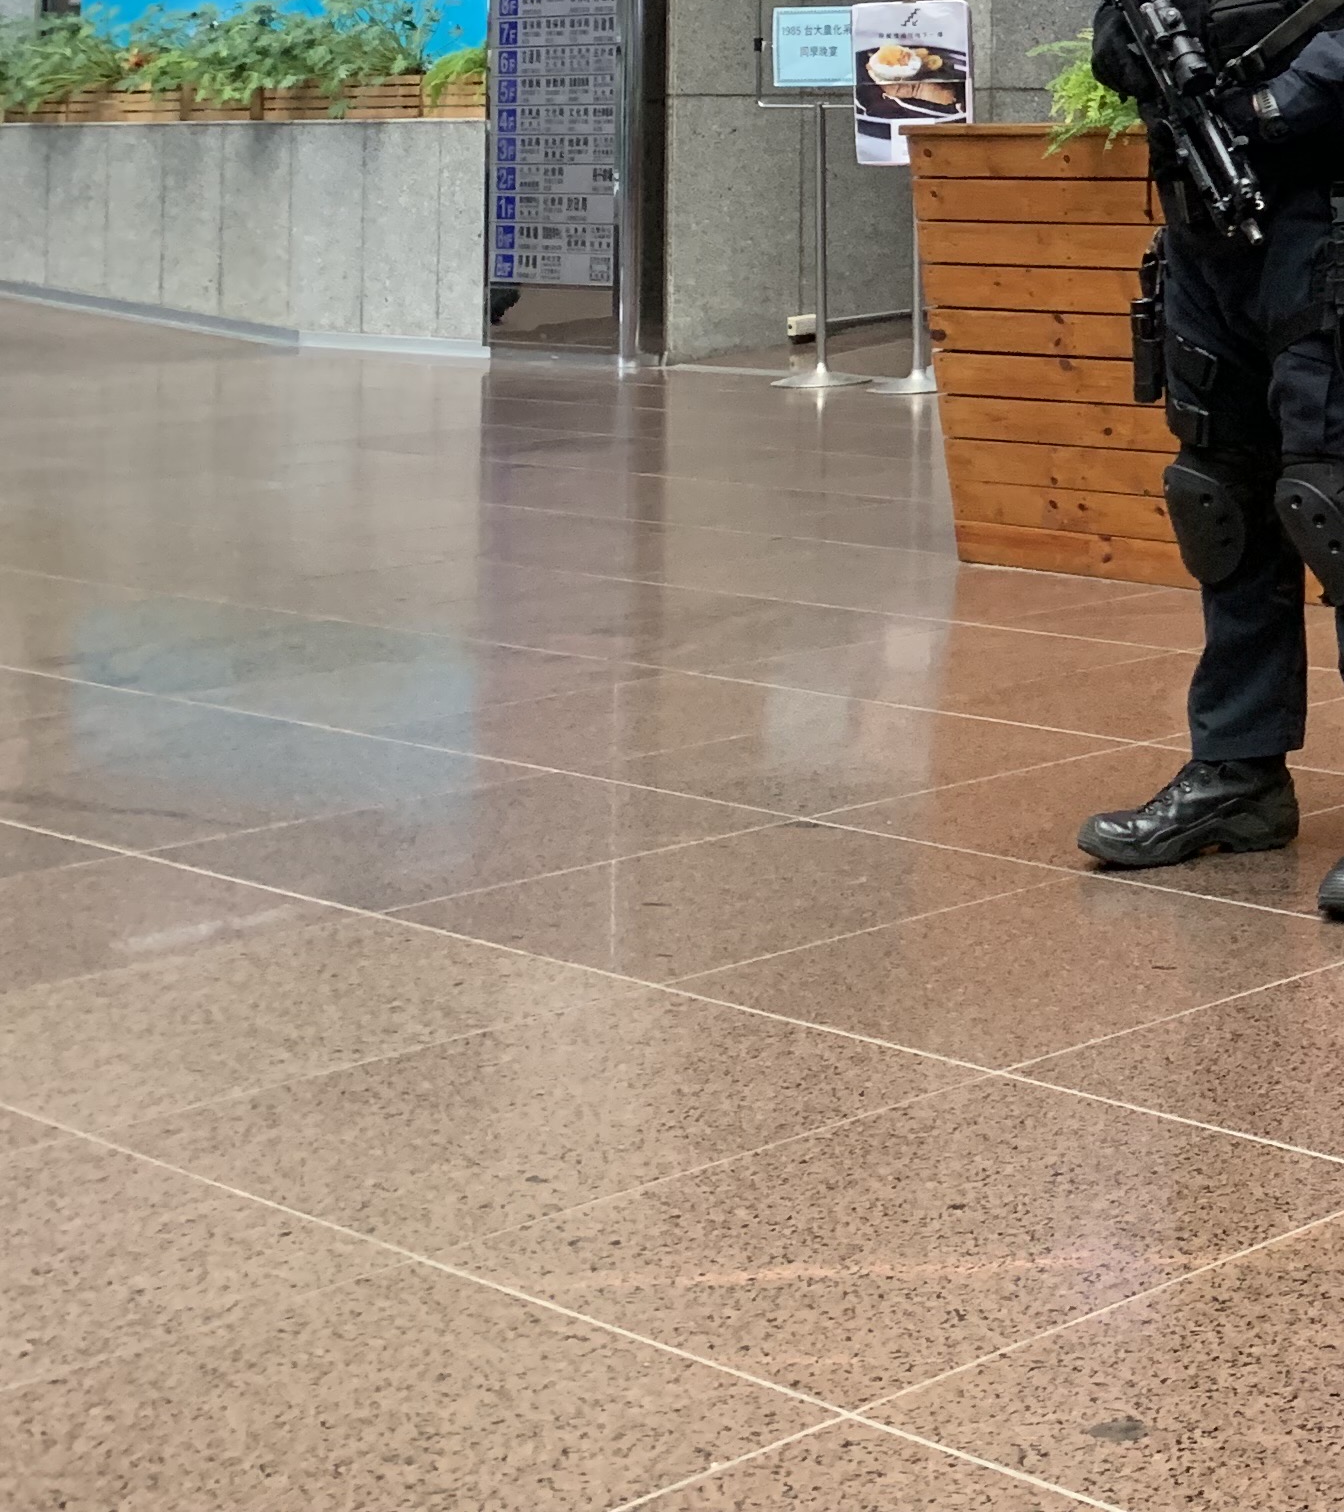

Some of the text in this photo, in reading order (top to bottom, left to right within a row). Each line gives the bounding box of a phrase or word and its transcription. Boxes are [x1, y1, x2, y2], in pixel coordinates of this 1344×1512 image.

[500, 23, 517, 44] 7F
[782, 24, 801, 36] 1985
[500, 52, 516, 73] 6F
[499, 81, 516, 102] 5F
[499, 110, 515, 131] 4F
[499, 139, 515, 160] 3F
[498, 168, 515, 189] 2F
[499, 197, 515, 218] 1F
